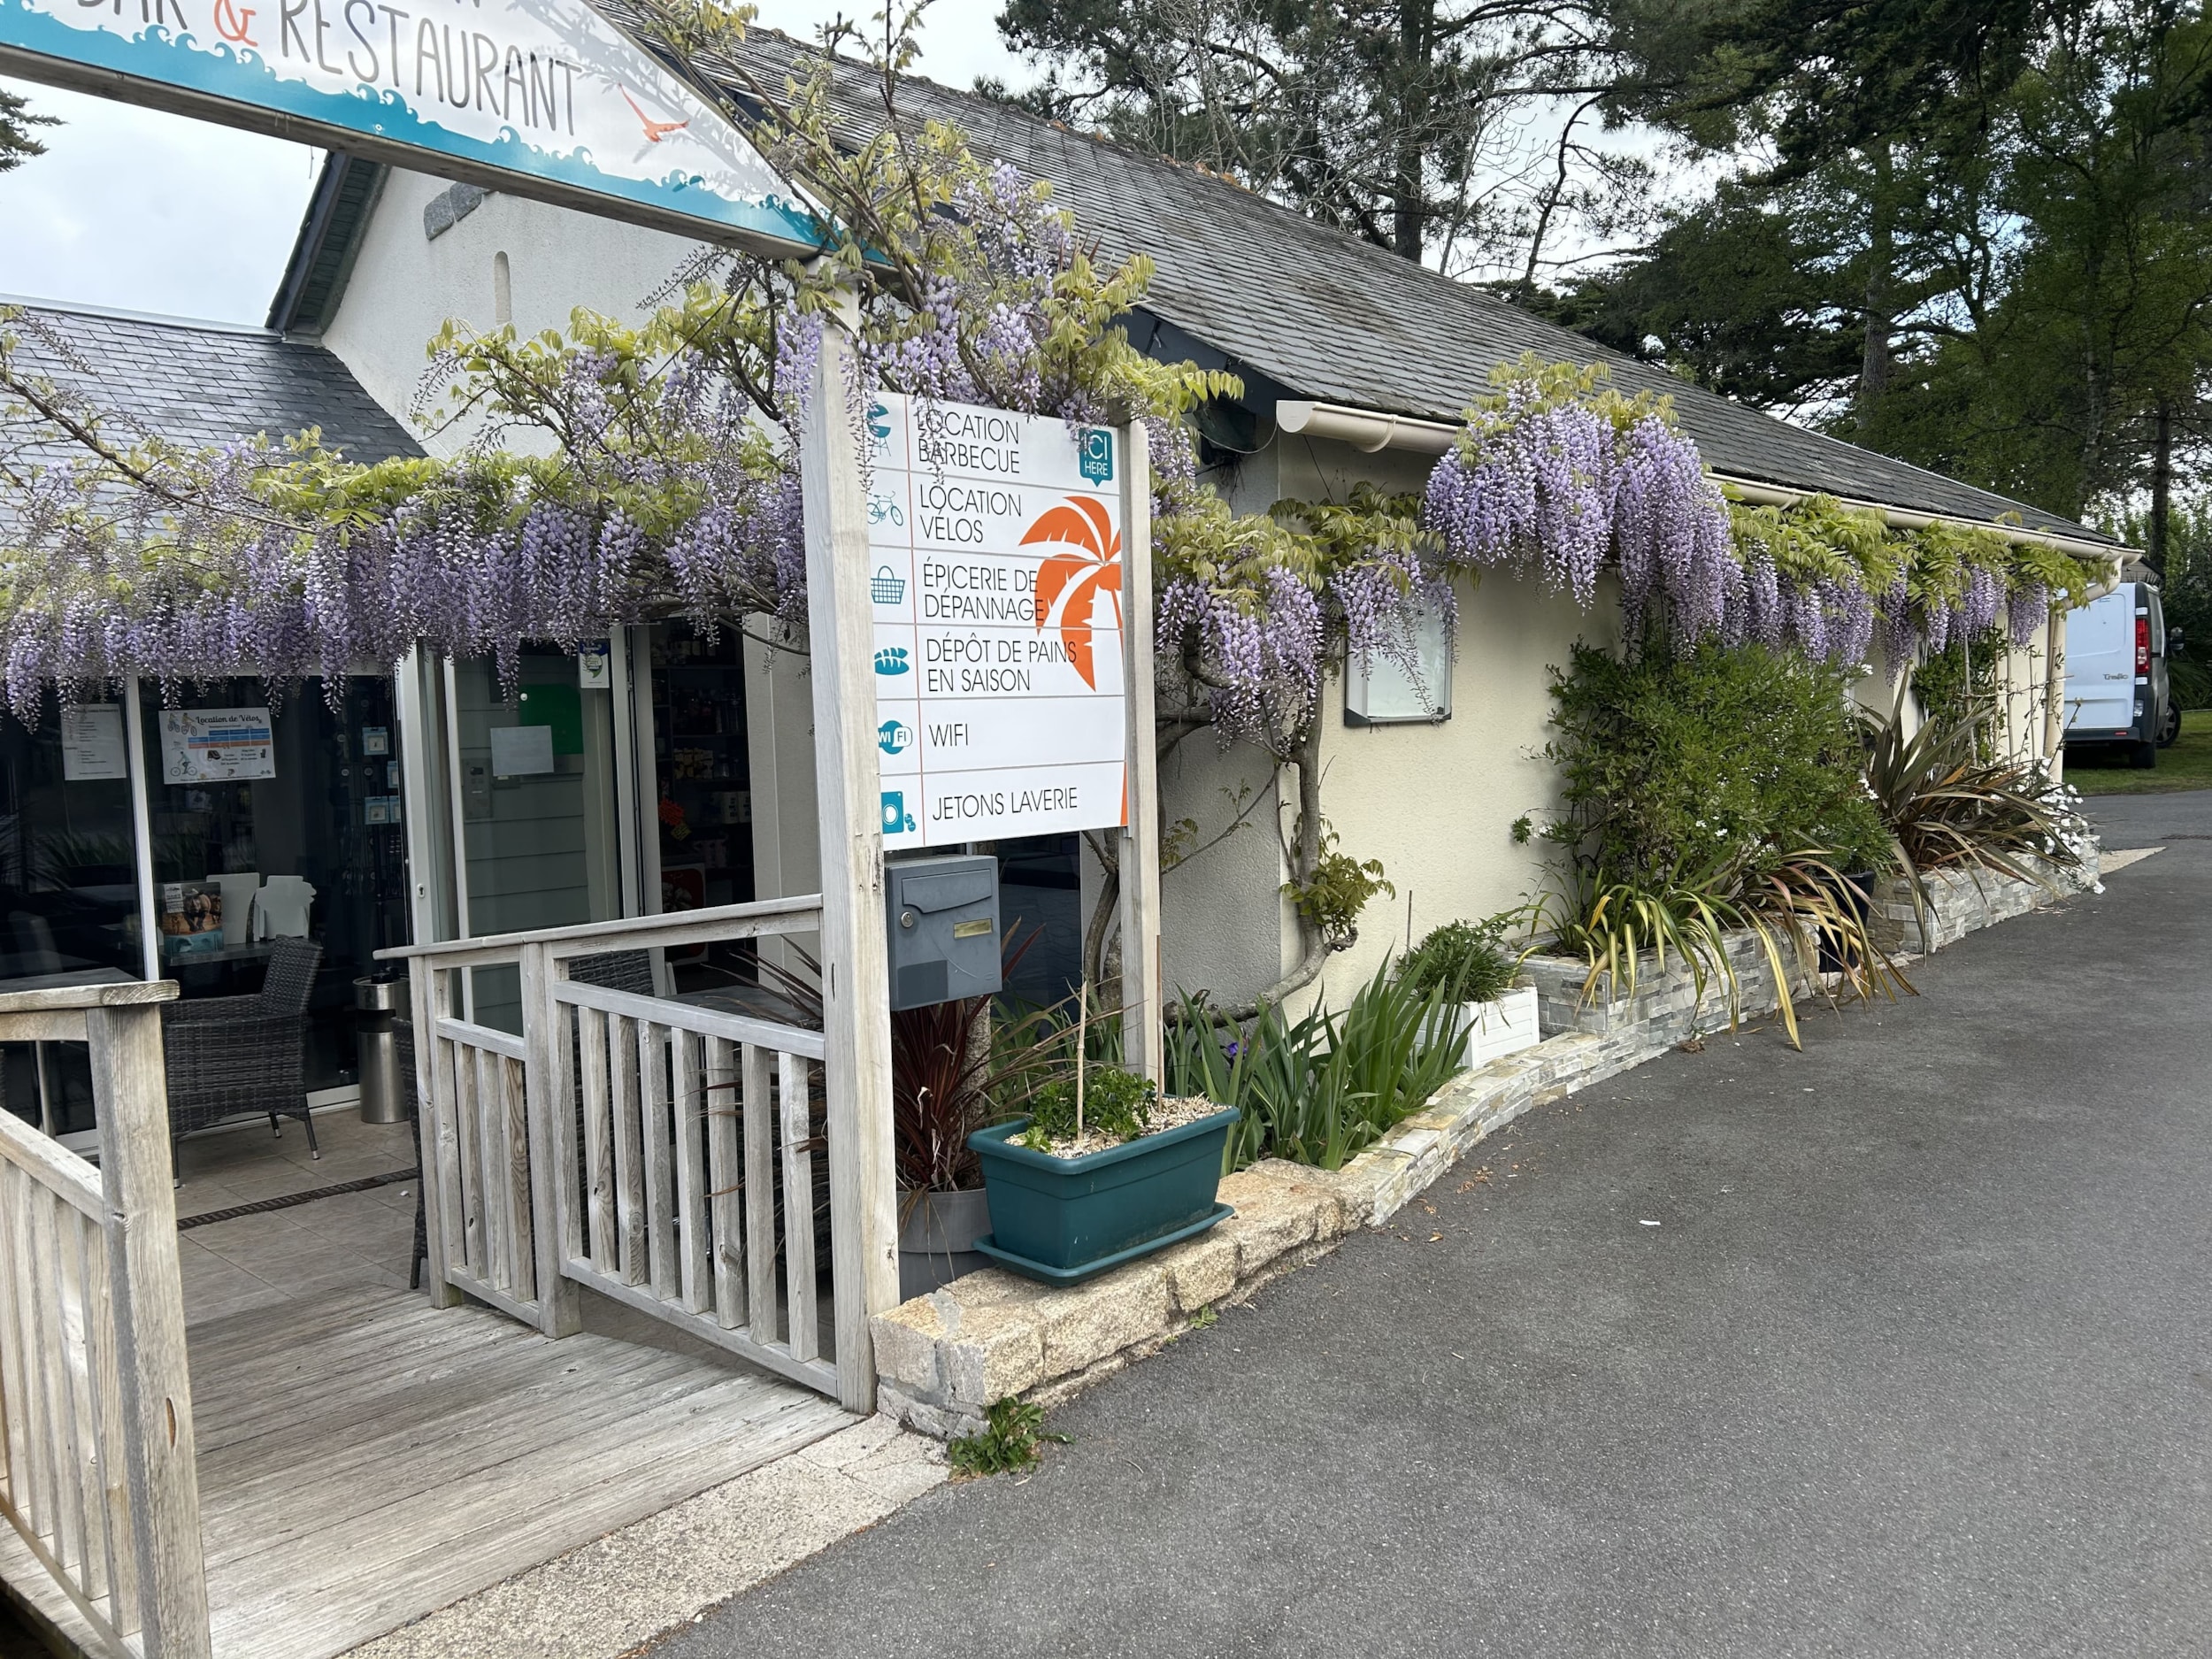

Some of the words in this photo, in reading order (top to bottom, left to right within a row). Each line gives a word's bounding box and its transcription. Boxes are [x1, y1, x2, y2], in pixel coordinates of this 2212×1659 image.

[213, 0, 258, 47] &
[280, 0, 583, 136] RESTAURANT
[917, 406, 1019, 445] LOCATION
[918, 438, 1020, 474] BARBECUE
[1084, 433, 1108, 460] ICI
[1084, 460, 1108, 476] HERE
[919, 483, 1022, 518] LOCATION
[919, 509, 984, 543] VÉLOS
[923, 556, 1007, 592] ÉPICERIE
[1015, 570, 1038, 593] DE
[925, 587, 1044, 622] DÉPANNAGE
[926, 631, 991, 664] DÉPÔT
[998, 641, 1022, 663] DE
[1028, 641, 1077, 664] PAINS
[928, 669, 954, 692] EN
[961, 669, 1030, 692] SAISON
[196, 715, 227, 726] Location
[897, 731, 907, 742] FI
[928, 723, 969, 748] WIFI
[932, 792, 1004, 821] JETONS
[1011, 787, 1078, 814] LAVERIE
